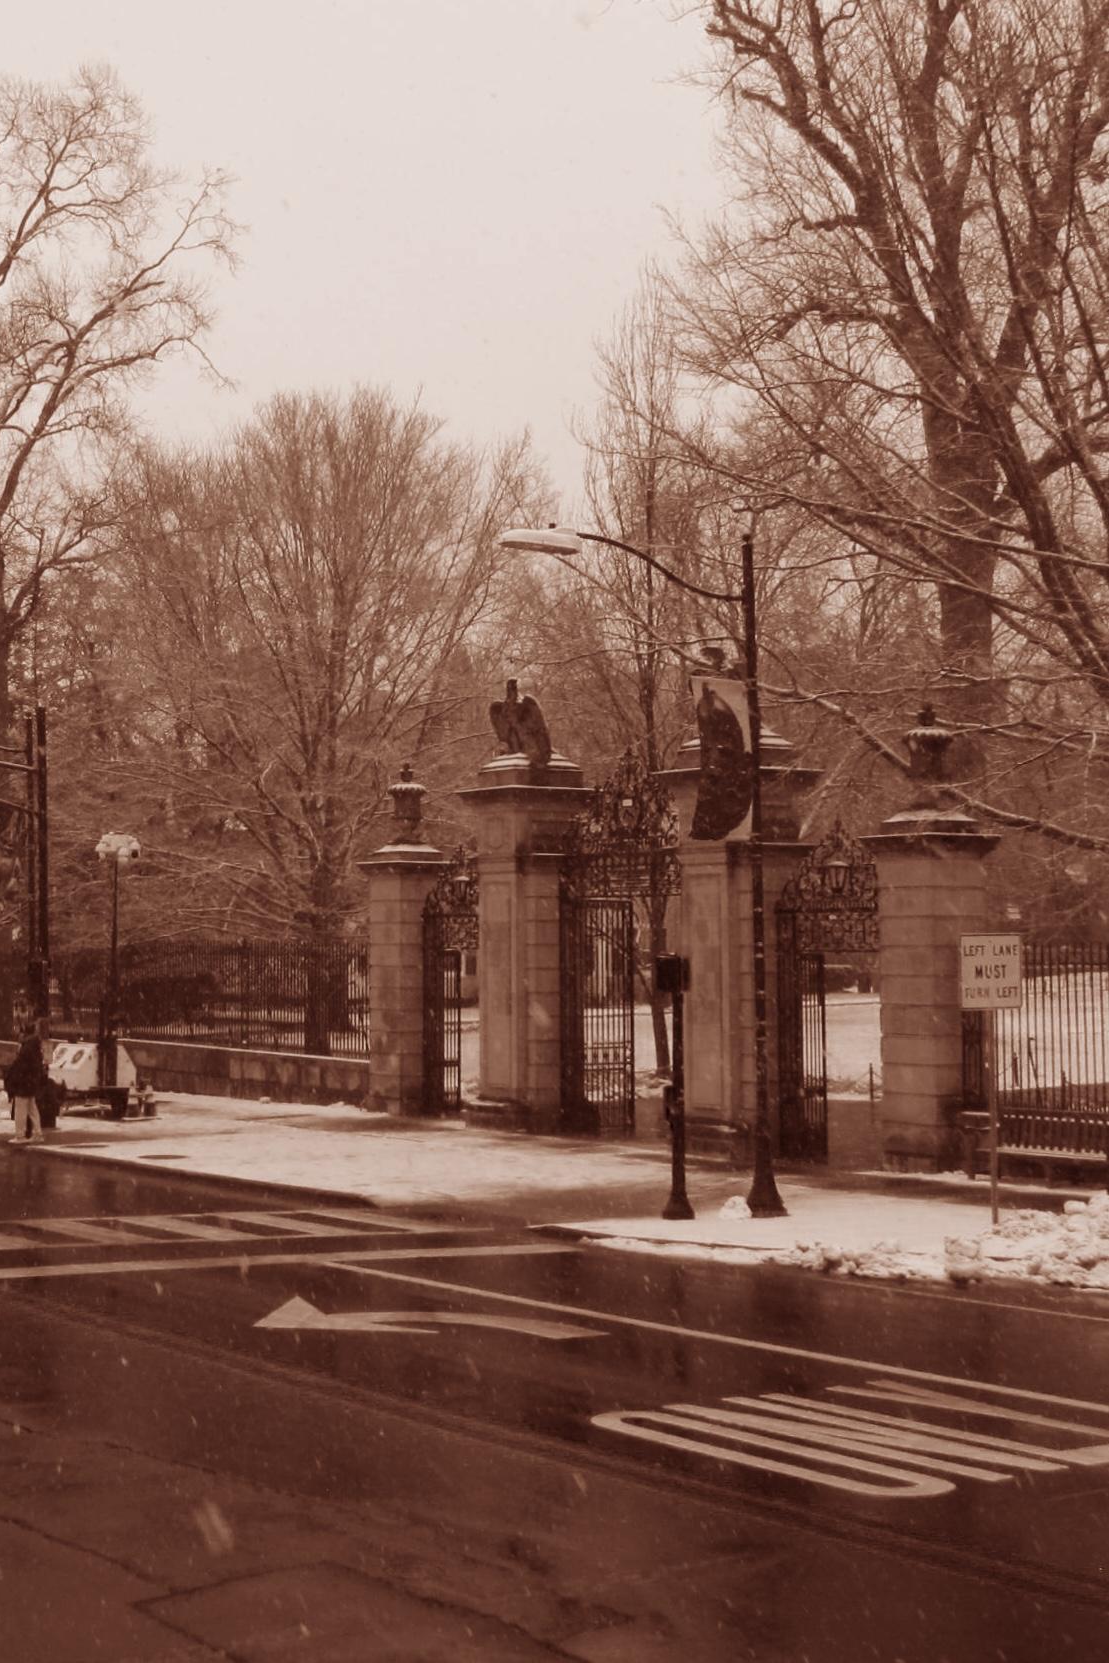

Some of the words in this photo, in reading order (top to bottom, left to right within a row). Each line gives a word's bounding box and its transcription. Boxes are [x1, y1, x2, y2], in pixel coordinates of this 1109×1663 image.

[963, 945, 986, 957] LEFT
[993, 944, 1018, 956] LANE
[975, 964, 1007, 979] MUST
[996, 986, 1018, 999] LEFT
